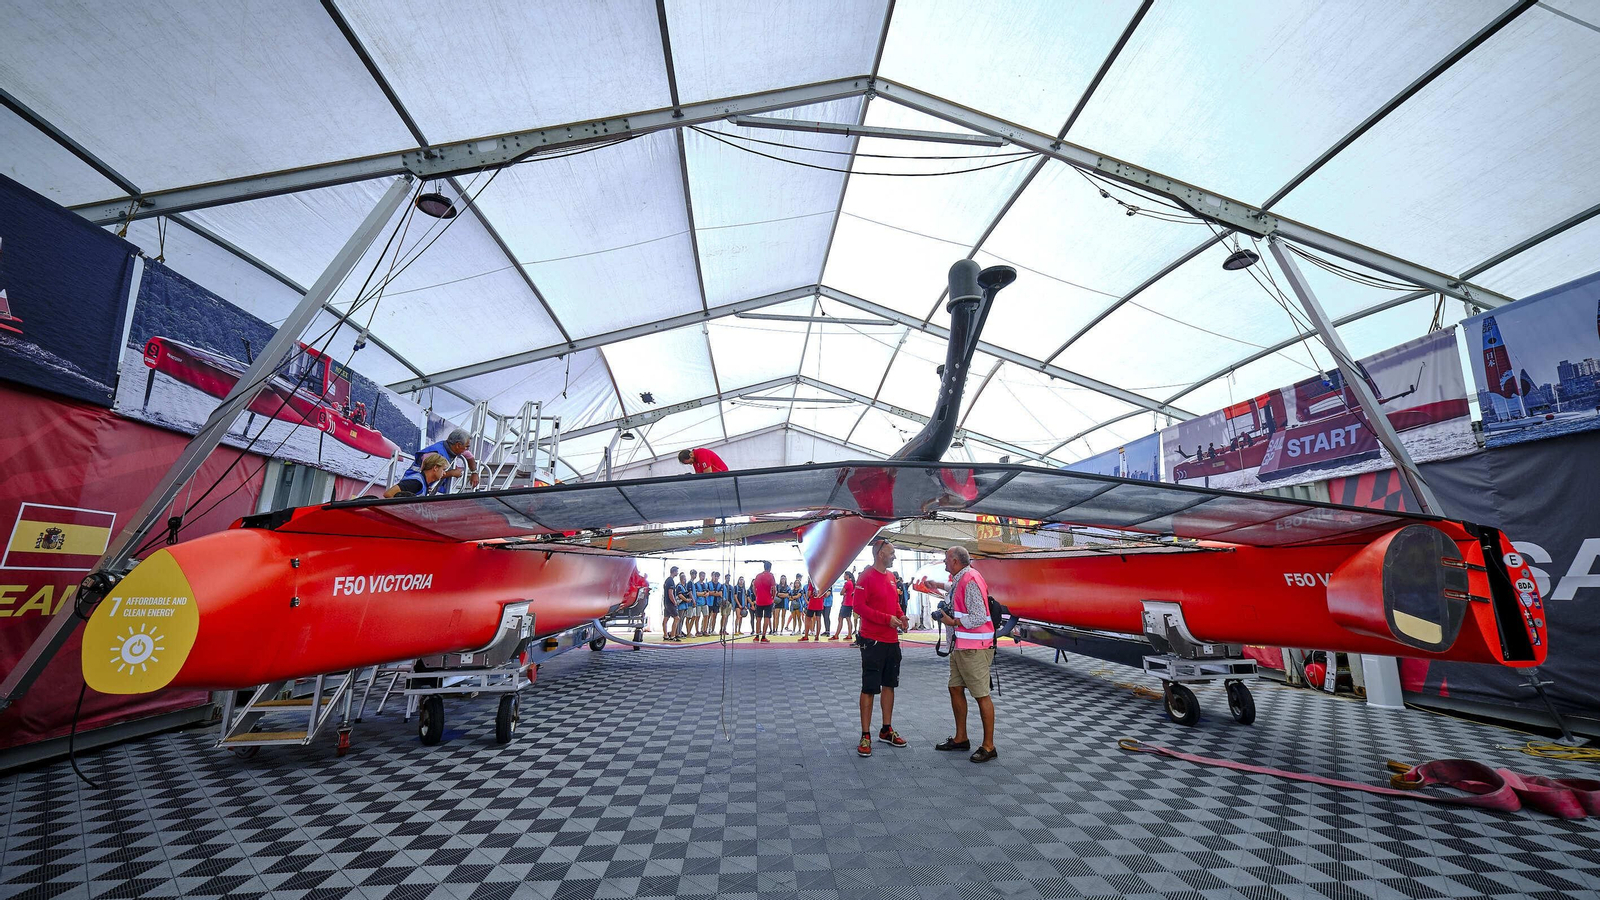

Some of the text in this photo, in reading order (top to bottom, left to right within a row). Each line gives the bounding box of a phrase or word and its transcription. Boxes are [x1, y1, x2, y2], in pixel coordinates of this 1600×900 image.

[1287, 423, 1362, 458] START
[1509, 554, 1518, 566] E
[332, 573, 434, 597] F50 VICTORIA
[1283, 572, 1333, 587] F50 V
[1517, 582, 1533, 590] BDA
[109, 597, 122, 617] 7
[126, 597, 187, 605] AFFORDABLE AND
[123, 608, 176, 617] CLEAN ENERGY
